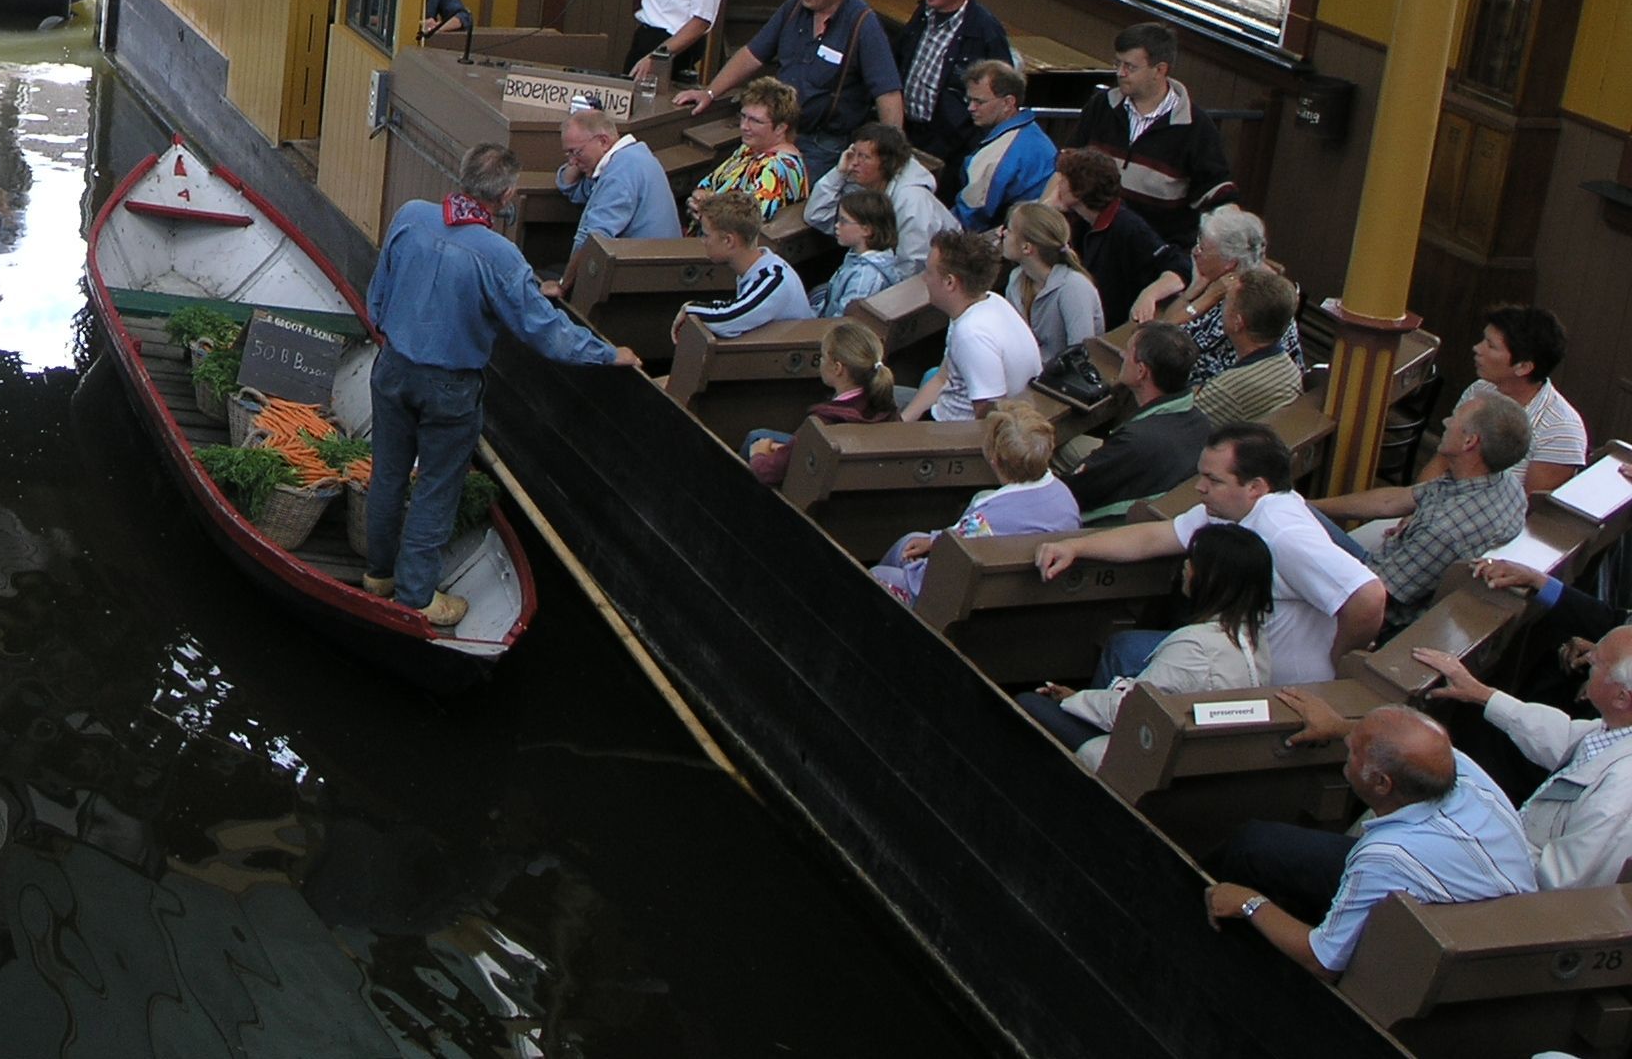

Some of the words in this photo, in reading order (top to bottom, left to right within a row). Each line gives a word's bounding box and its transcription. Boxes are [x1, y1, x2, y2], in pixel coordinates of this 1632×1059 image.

[252, 340, 275, 360] 50
[948, 461, 964, 473] 13
[1096, 571, 1114, 585] 18
[1592, 950, 1622, 970] 28
